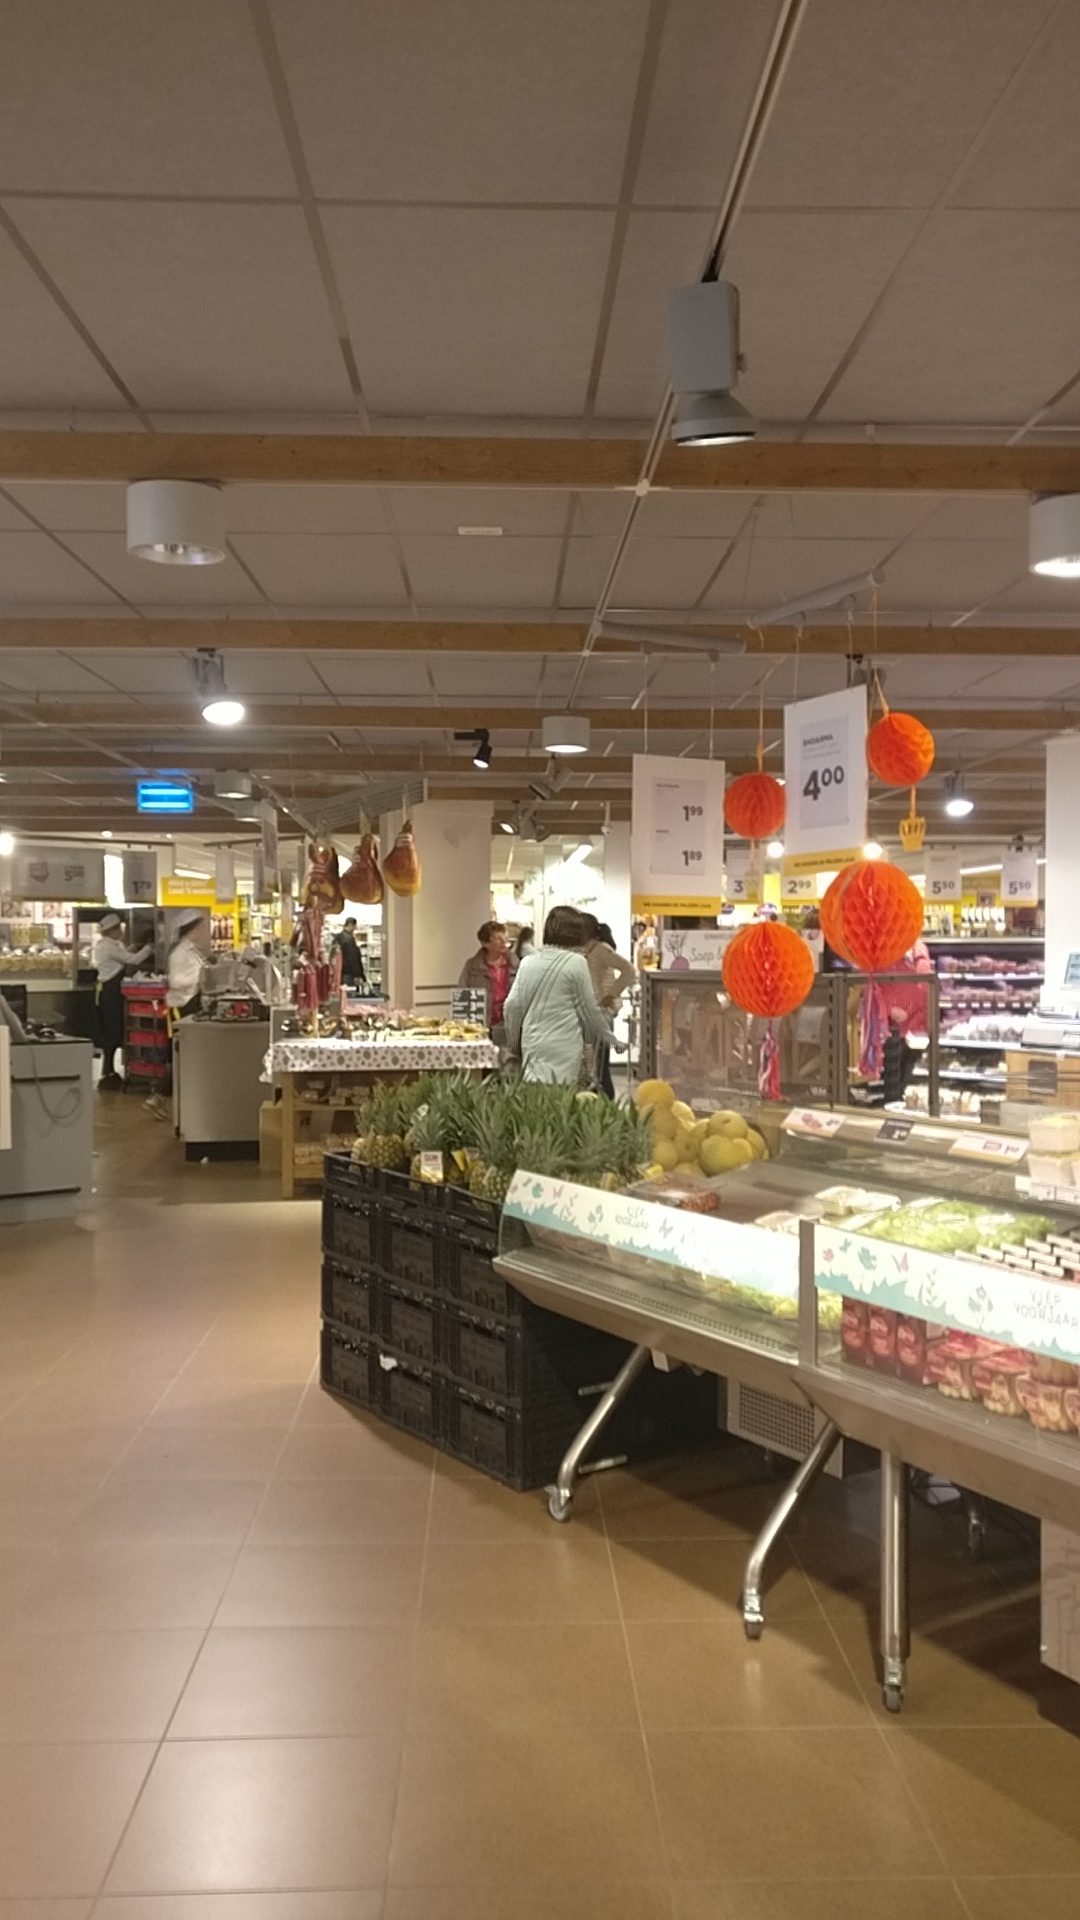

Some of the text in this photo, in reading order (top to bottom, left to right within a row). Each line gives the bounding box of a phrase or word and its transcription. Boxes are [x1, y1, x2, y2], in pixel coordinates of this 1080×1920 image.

[803, 765, 844, 800] 400
[683, 805, 703, 821] 199
[682, 850, 702, 866] 189
